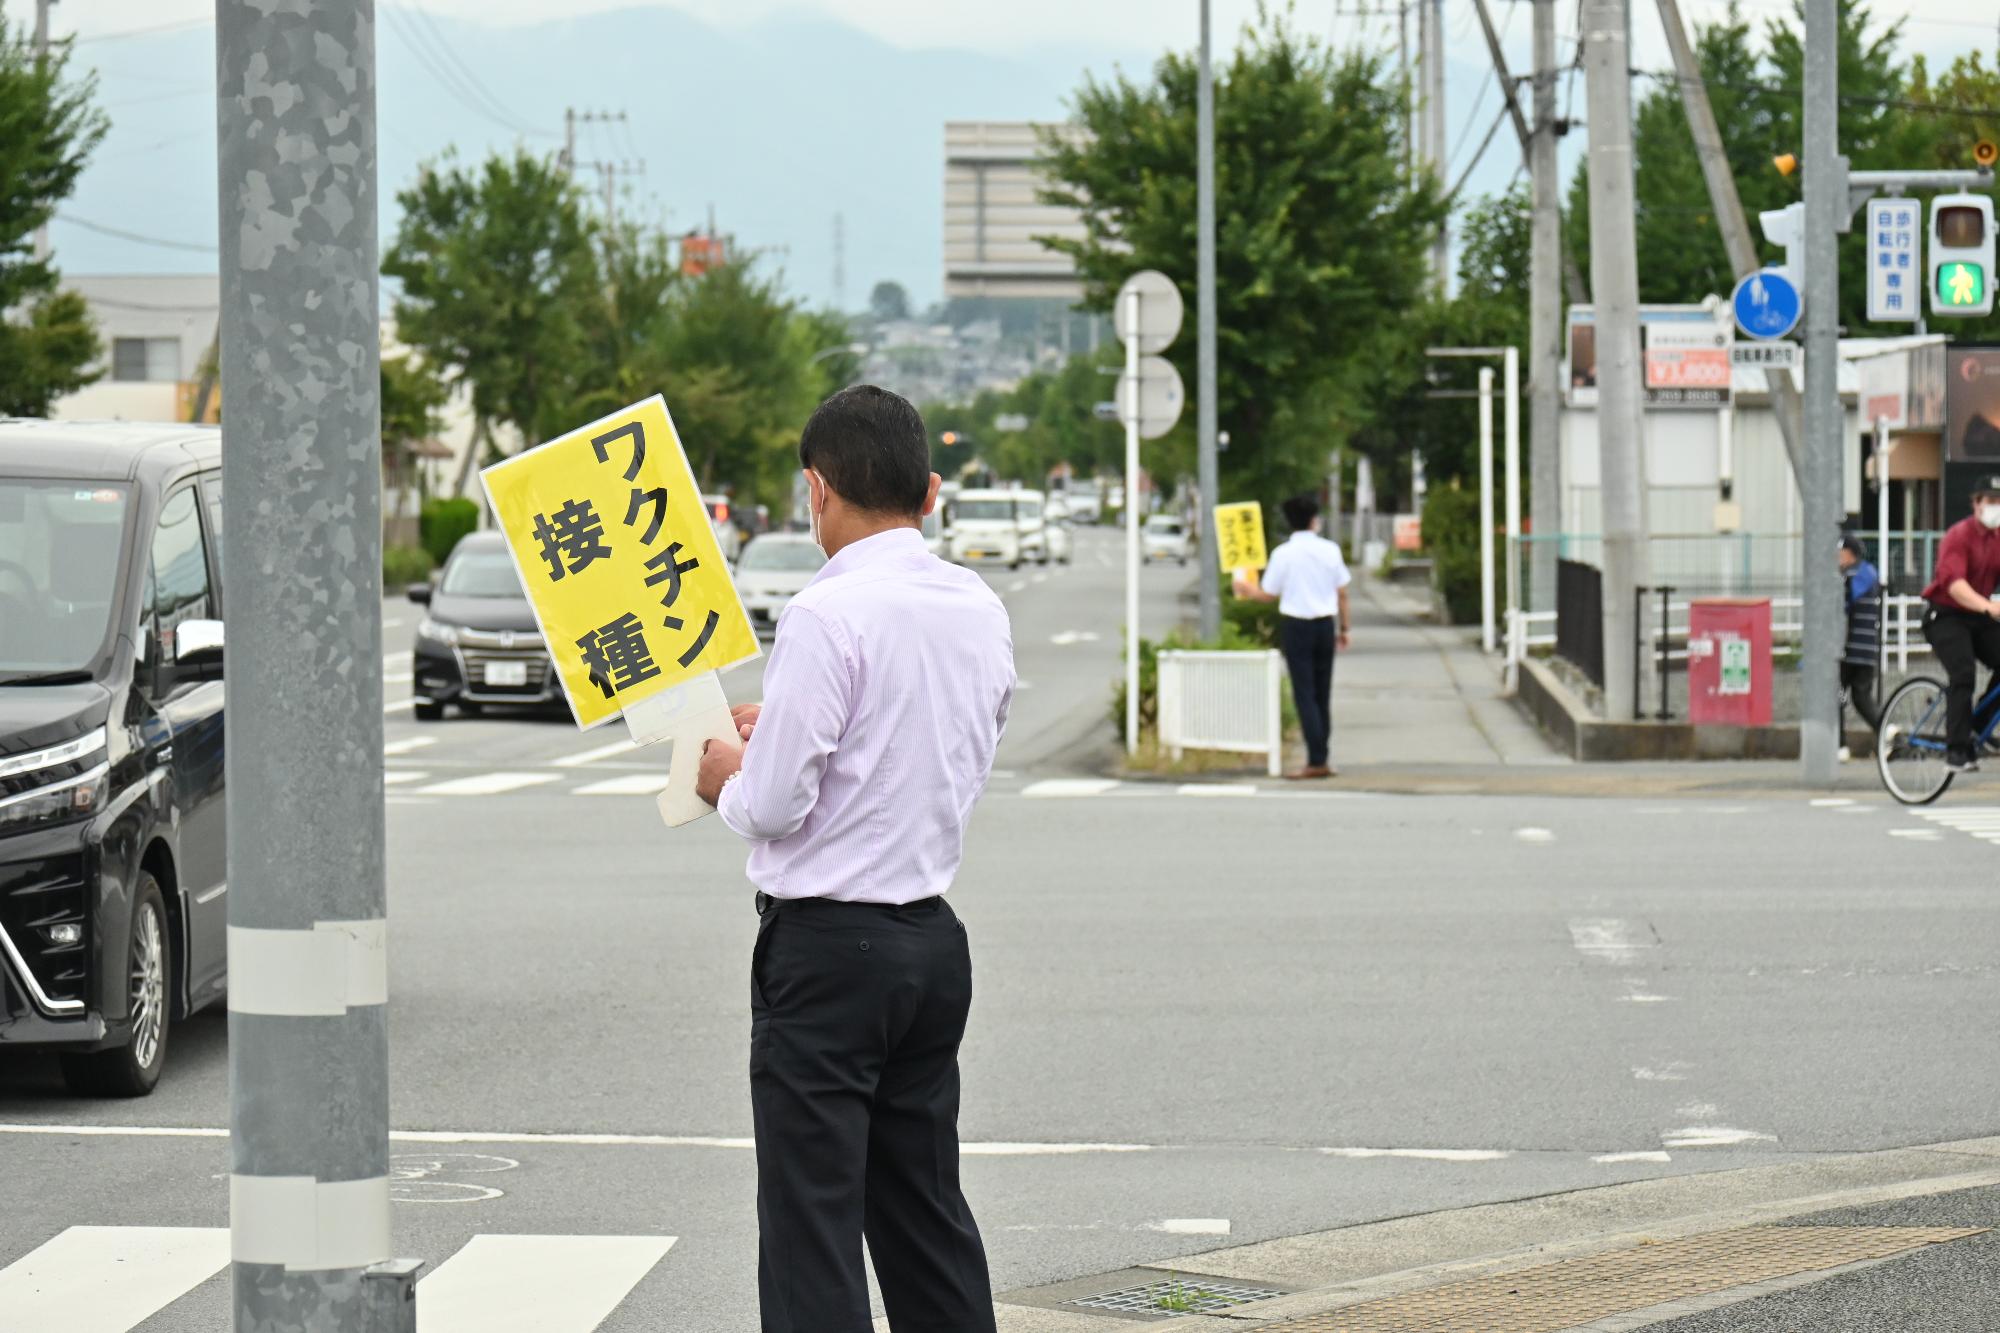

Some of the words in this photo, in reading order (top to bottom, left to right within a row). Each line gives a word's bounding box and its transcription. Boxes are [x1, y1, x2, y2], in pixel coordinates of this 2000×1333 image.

[1886, 273, 1903, 310] 専用
[532, 499, 662, 698] 接種
[590, 421, 720, 668] ワクチン
